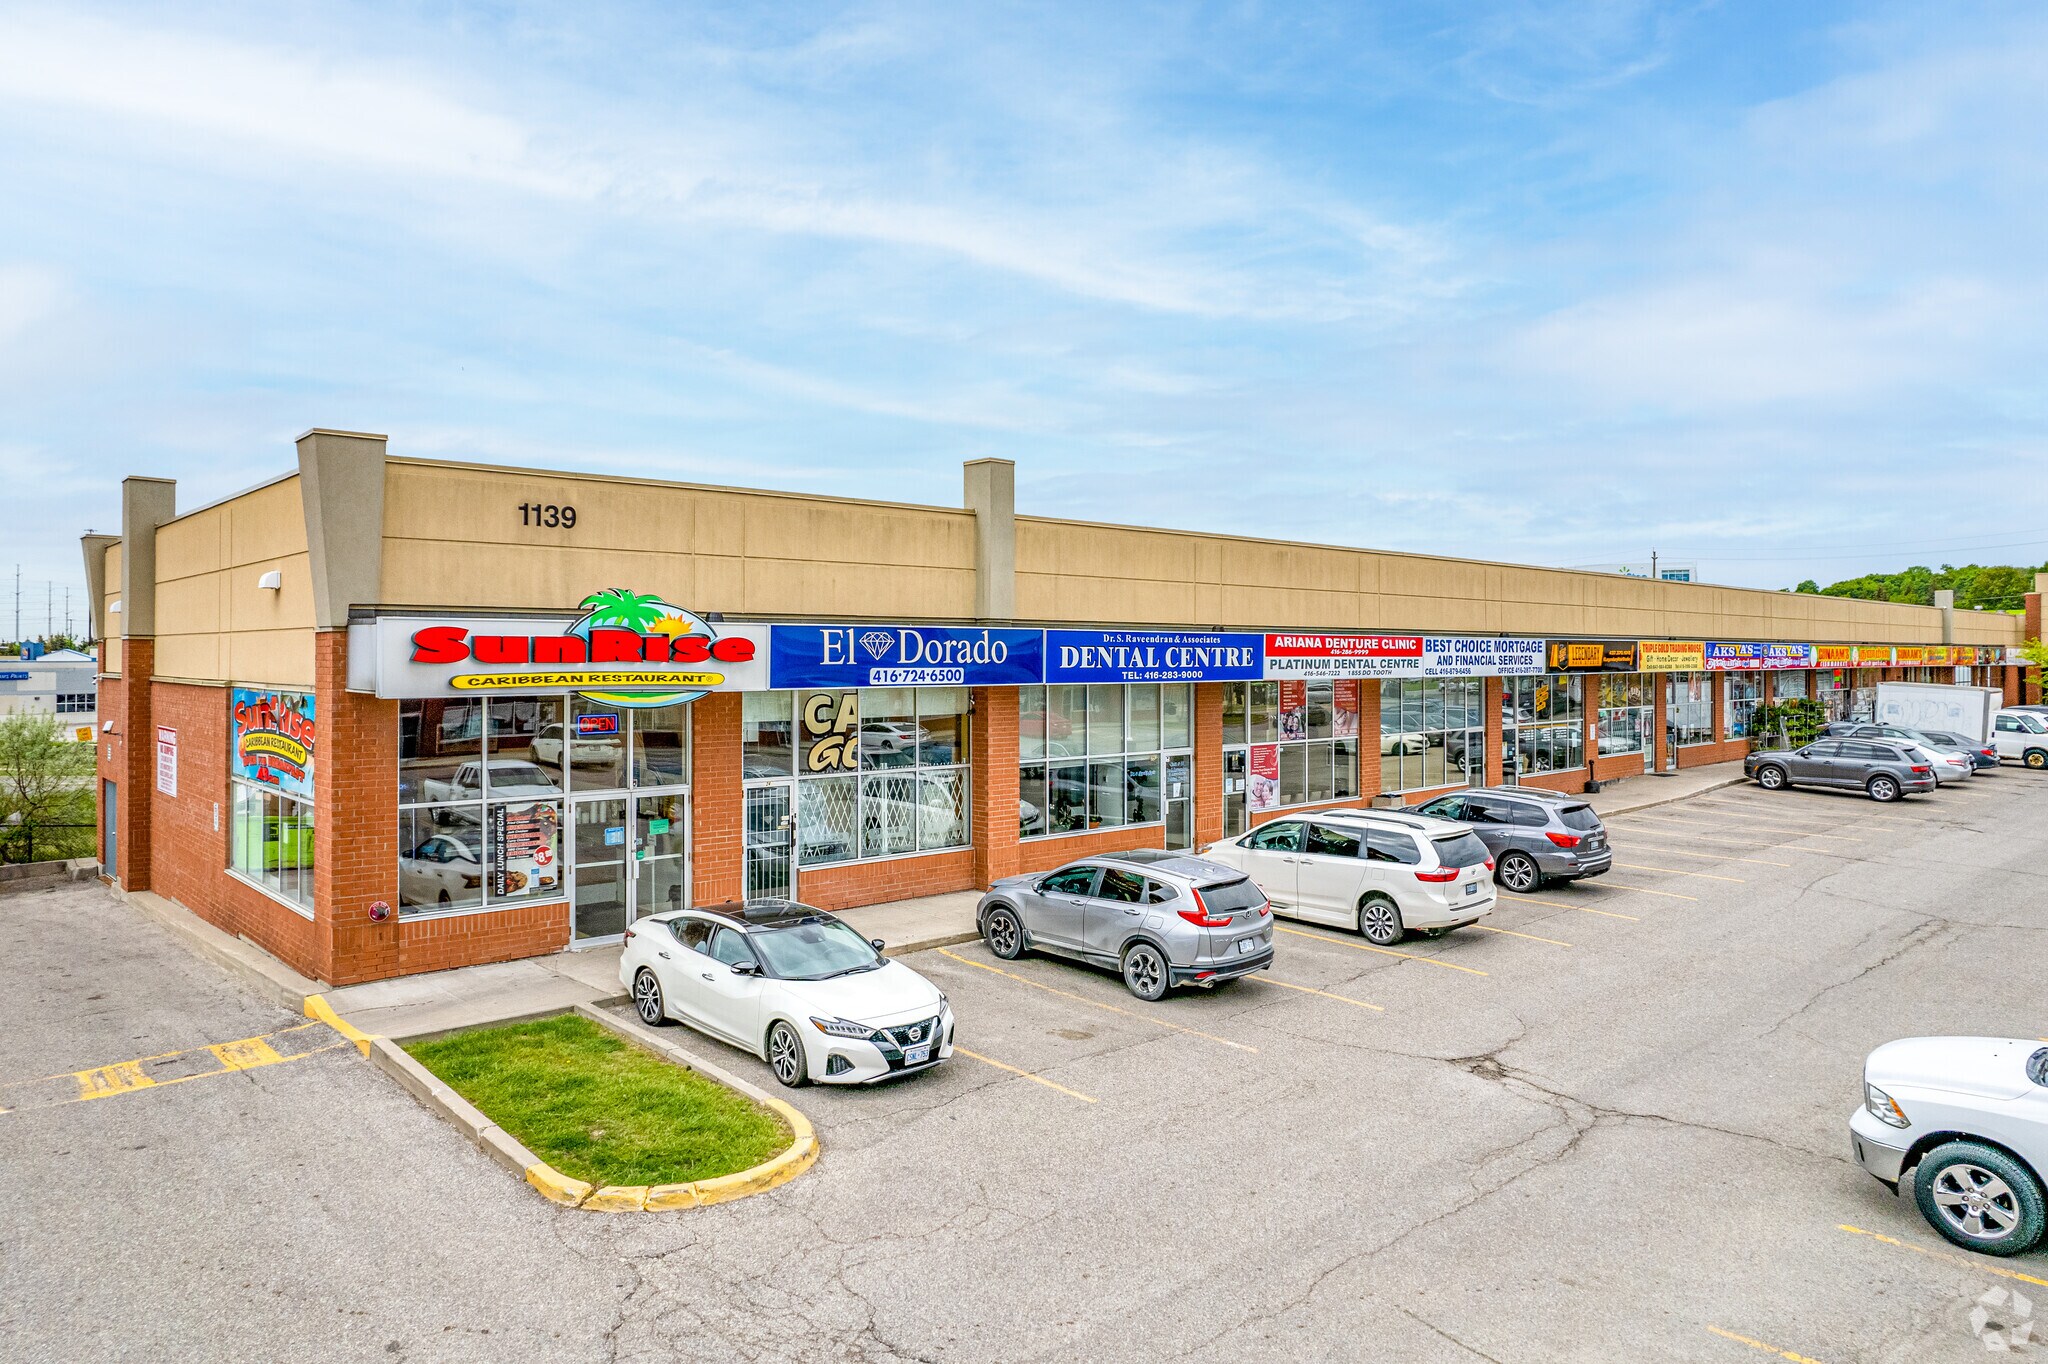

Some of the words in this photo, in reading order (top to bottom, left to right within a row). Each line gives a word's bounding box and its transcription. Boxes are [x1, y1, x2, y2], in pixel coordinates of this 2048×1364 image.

[518, 503, 577, 529] 1139
[1125, 634, 1173, 643] Raveendran
[1174, 635, 1181, 643] &
[1182, 635, 1221, 644] Associates
[1274, 636, 1322, 648] ARIANA
[1325, 637, 1379, 649] DENTURE
[1381, 639, 1417, 650] CLINIC
[1425, 639, 1452, 652] BEST
[1454, 639, 1492, 653] CHOICE
[1494, 640, 1543, 653] MORTGAGE
[819, 628, 858, 666] El
[897, 629, 1008, 664] Dorado
[1642, 643, 1657, 653] TRIPLE
[1657, 643, 1669, 653] GOLD
[1670, 643, 1688, 653] TRADING
[1688, 644, 1702, 653] HOUSE
[1059, 646, 1160, 668] DENTAL
[1165, 646, 1254, 668] CENTRE
[1269, 659, 1331, 670] PLATINUM
[1334, 658, 1377, 669] DENTAL
[1379, 658, 1420, 669] CENTRE
[1436, 655, 1453, 666] AND
[1455, 655, 1497, 666] FINANCIAL
[1498, 655, 1534, 665] SERVICES
[467, 674, 583, 687] CARIBBEAN
[1121, 671, 1143, 680] TEL:
[1144, 670, 1203, 680] 416-283-9000
[580, 716, 615, 732] OPEN
[496, 808, 505, 842] SPECIAL
[496, 843, 505, 871] LUNCH
[496, 871, 505, 895] DAILY
